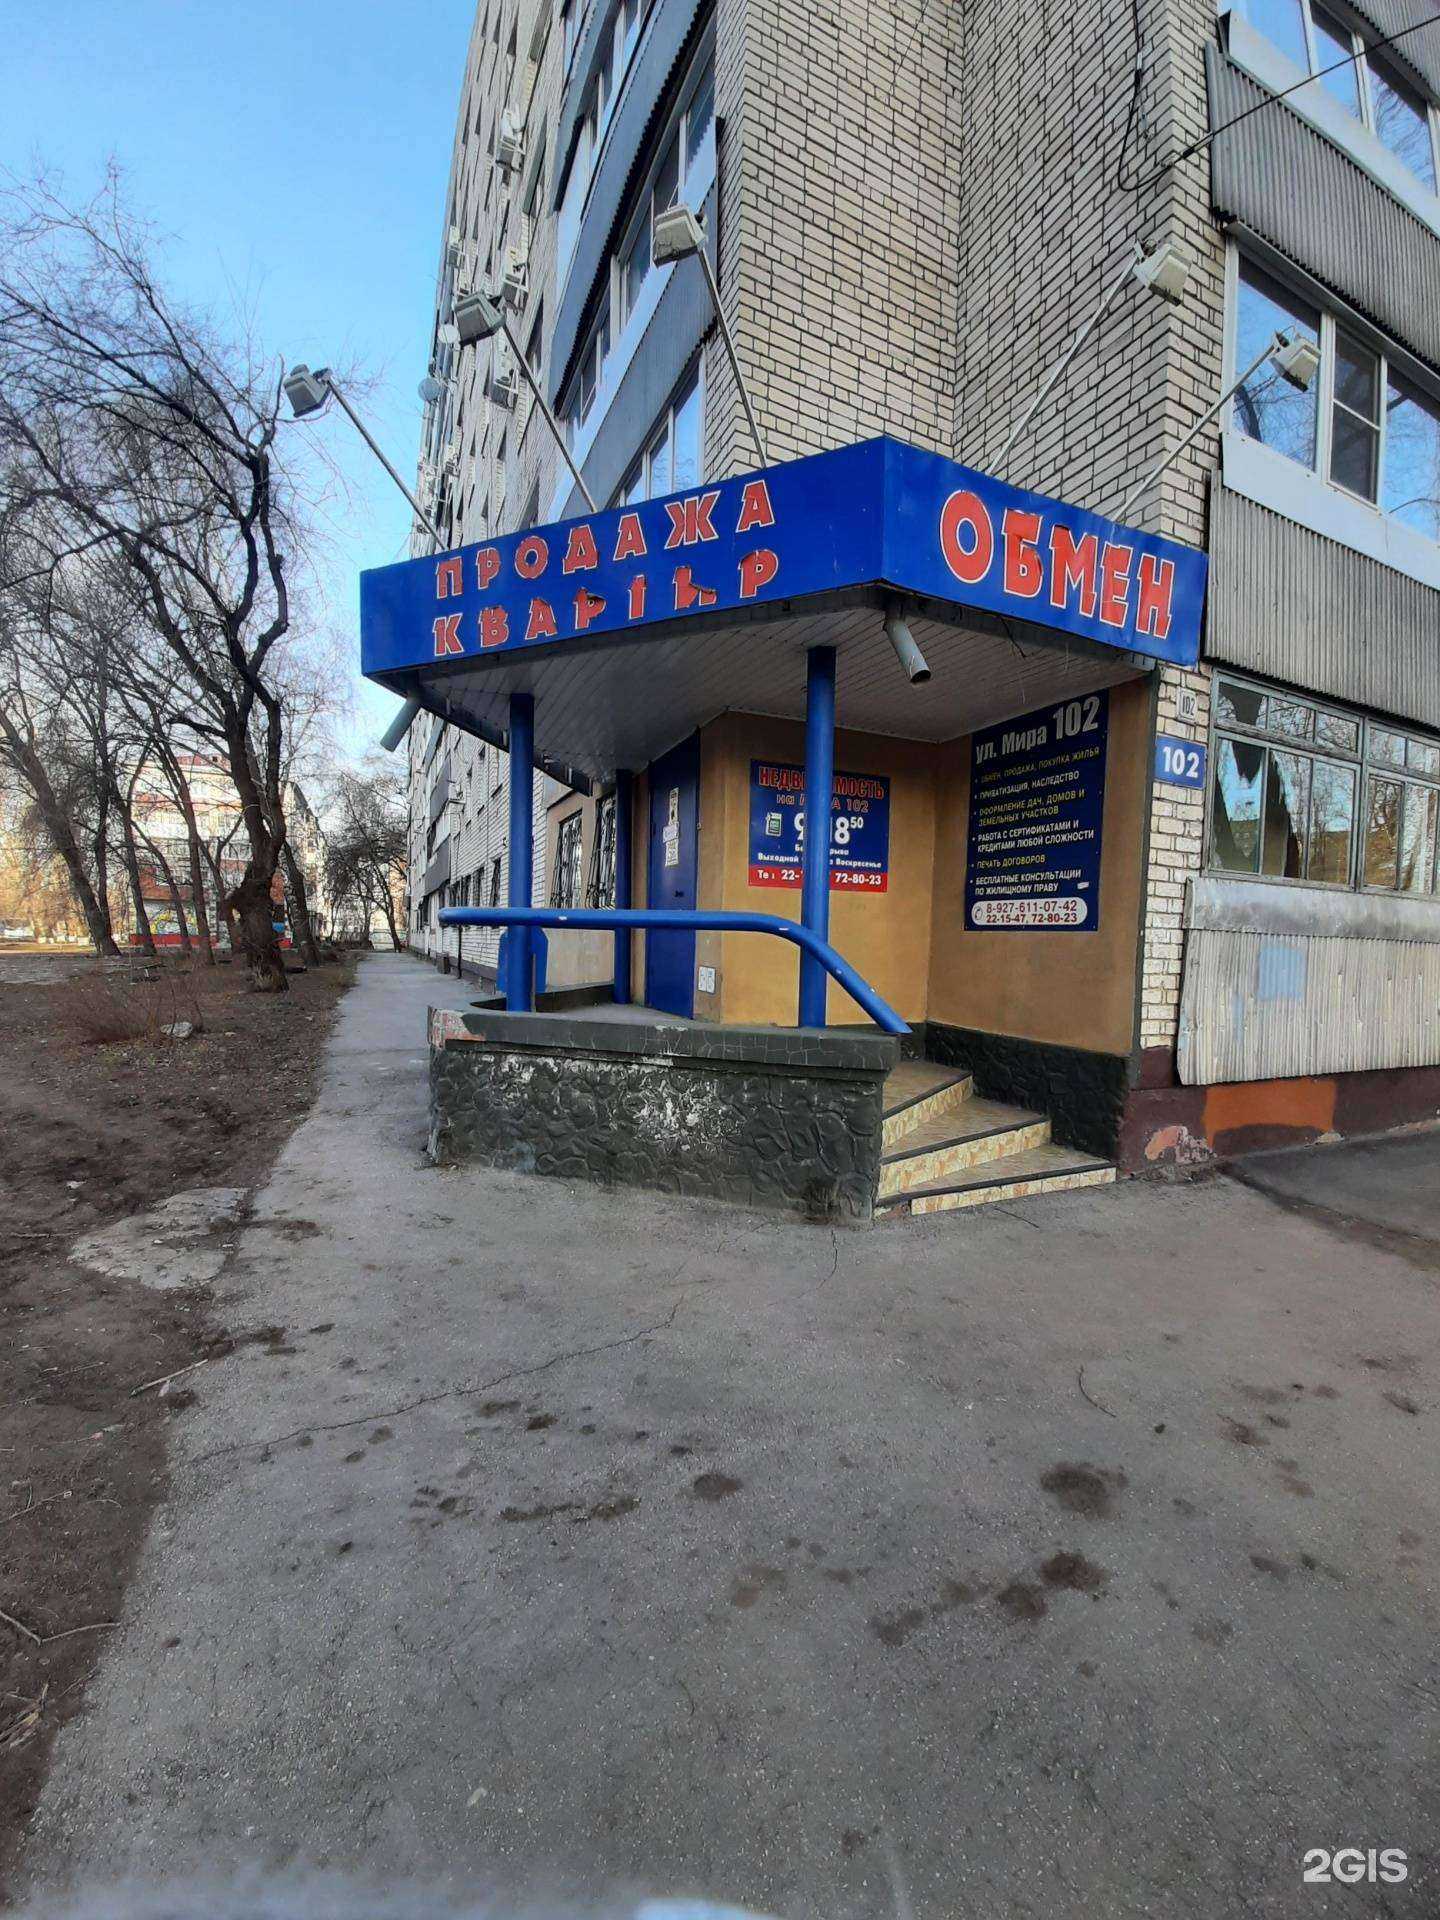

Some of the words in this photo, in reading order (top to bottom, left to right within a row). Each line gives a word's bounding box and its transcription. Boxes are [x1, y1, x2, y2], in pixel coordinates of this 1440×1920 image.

[435, 479, 776, 600] ПРОДАЖА
[940, 489, 1175, 640] ОБМЕН
[1182, 695, 1196, 716] 102
[976, 742, 997, 765] ул.
[1002, 726, 1047, 755] Мира
[1053, 696, 1100, 740] 102
[1162, 746, 1200, 778] 102
[1031, 770, 1080, 788] НАСЛЕДСТВО
[847, 799, 869, 813] 102
[979, 800, 1025, 816] ОФОРМЛЕНИЕ
[1047, 790, 1076, 804] ДОМОВ
[1078, 789, 1085, 798] И
[979, 813, 1019, 827] ЗЕМЕЛЬНЫХ
[1022, 805, 1059, 819] УЧАСТКОВ
[978, 832, 1001, 842] РАБОТА
[1009, 820, 1071, 838] СЕРТИФИКАТАМИ
[1073, 819, 1079, 829] И
[978, 840, 1015, 853] КРЕДИТАМИ
[1017, 835, 1043, 848] ЛЮБОЙ
[1045, 829, 1094, 844] СЛОЖНОСТИ
[977, 859, 1001, 869] ПЕЧАТЬ
[1002, 854, 1046, 867] ДОГОВОРОВ
[835, 872, 882, 885] 72-80-23
[976, 871, 1019, 885] БЕСПЛАТНЫЕ
[1021, 869, 1081, 882] КОНСУЛЬТАЦИИ
[975, 886, 985, 896] ПО
[986, 885, 1032, 896] ЖИЛИЩНОМУ
[1034, 882, 1059, 893] ПРАВУ
[986, 900, 1078, 914] 8-927-611-07-42
[1031, 912, 1078, 923] 72-80-23
